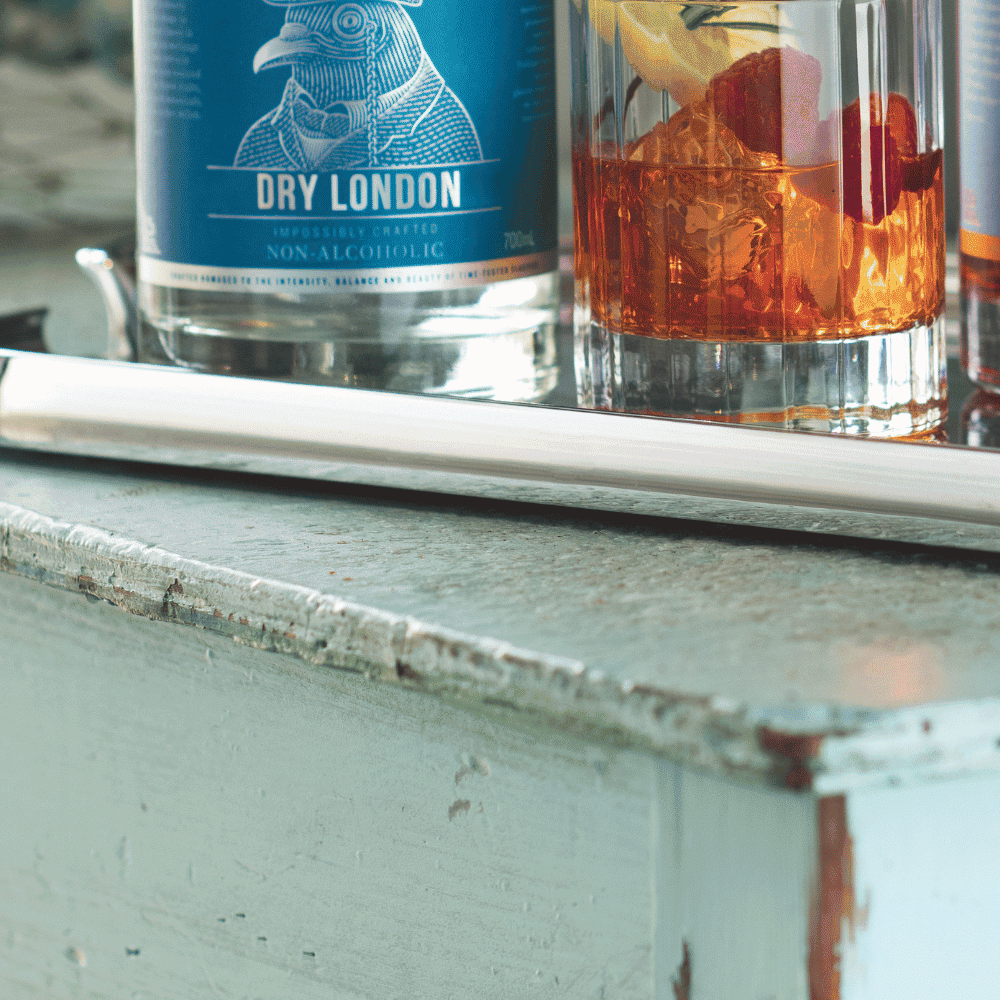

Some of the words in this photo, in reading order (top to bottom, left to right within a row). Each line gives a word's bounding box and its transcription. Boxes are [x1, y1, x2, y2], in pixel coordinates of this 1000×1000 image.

[256, 172, 318, 211] DRY
[331, 170, 461, 211] LONDON
[273, 226, 365, 240] IMPOSSIBLY
[372, 223, 439, 237] CRAFTED
[267, 242, 445, 261] NON-ALCOHOLIC
[241, 276, 251, 286] TO
[335, 276, 379, 287] BALANCE
[406, 273, 442, 284] BEAUTY
